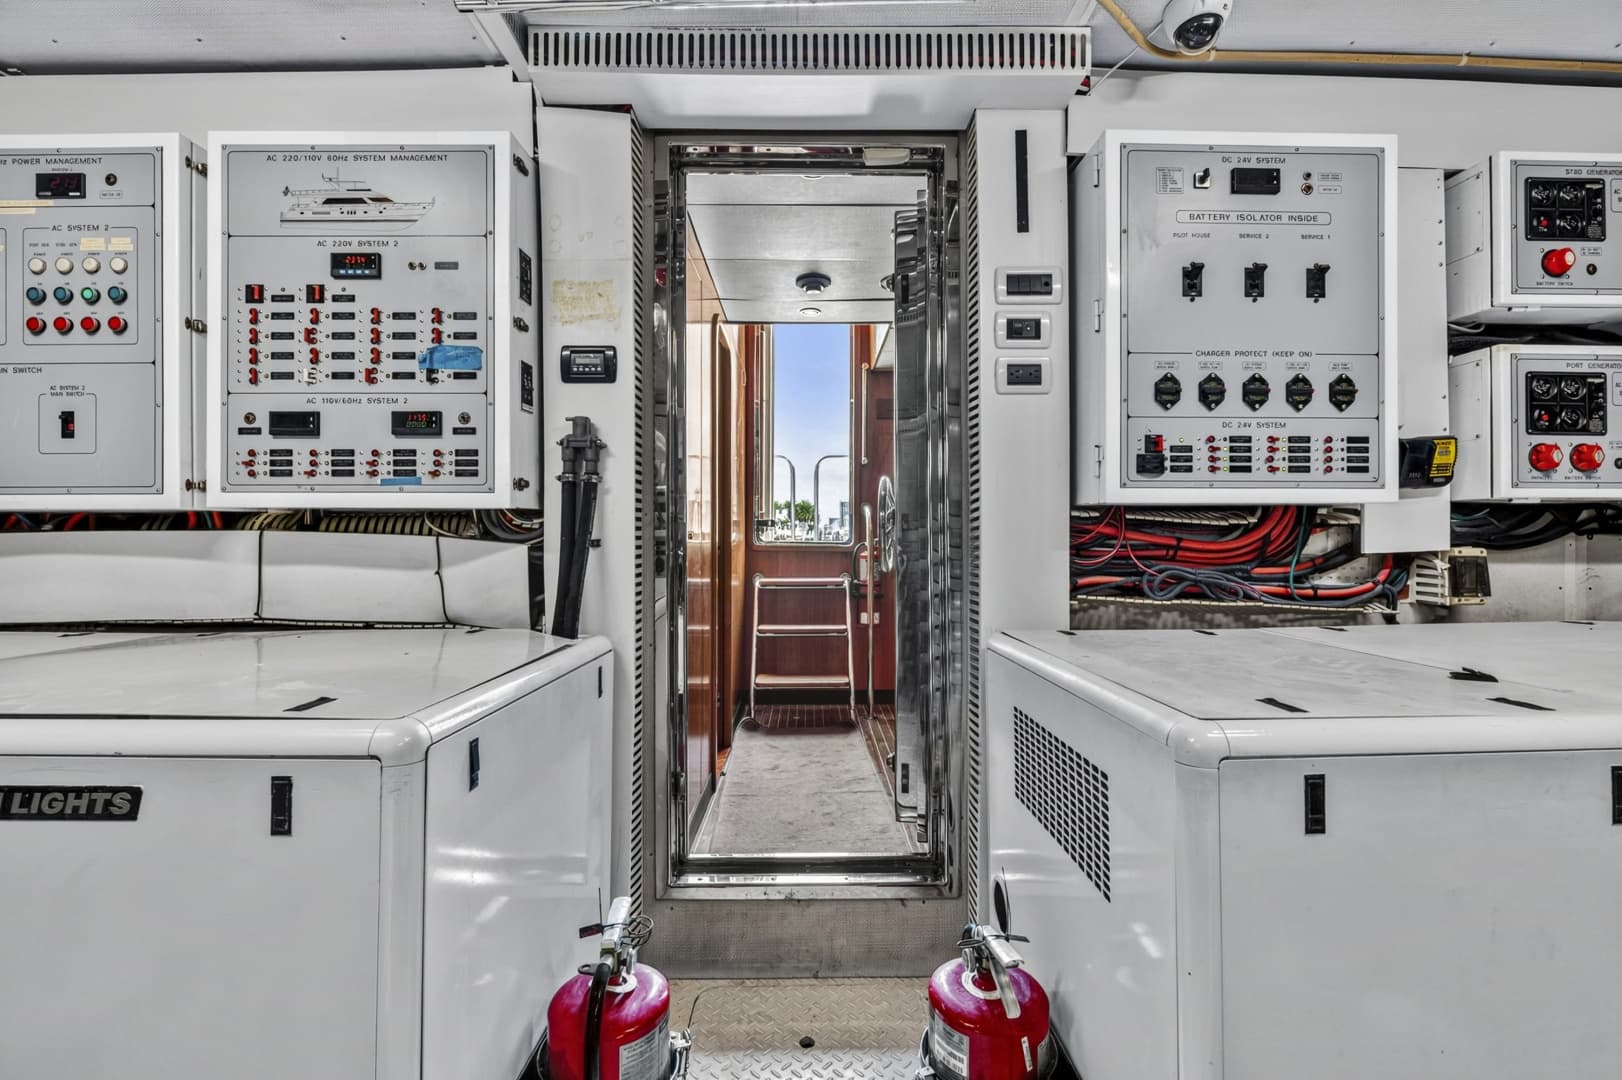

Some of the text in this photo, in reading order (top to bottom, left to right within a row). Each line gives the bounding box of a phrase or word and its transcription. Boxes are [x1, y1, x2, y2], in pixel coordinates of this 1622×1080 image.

[11, 157, 41, 166] POWER
[45, 157, 103, 165] MANAGEMENT
[266, 154, 449, 162] AC 220/110V 60Hz SYSTEM MANAGEMENT
[1221, 155, 1287, 165] DC 24V SYSTEM
[1188, 212, 1319, 223] BATTERY ISOLATOR INSIDE
[51, 224, 110, 232] AC SYSTEM 2
[1172, 231, 1189, 239] PILOT
[1300, 233, 1325, 241] SERVICE
[316, 239, 328, 248] AC
[332, 239, 353, 248] 220V
[357, 239, 389, 248] SYSTEM
[1195, 349, 1313, 358] CHARGER PROTECT (KEEP ON)
[12, 366, 43, 374] SWITCH
[305, 397, 317, 405] AC
[366, 397, 399, 405] SYSTEM
[1221, 421, 1287, 429] DC 24V SYSTEM
[10, 792, 132, 814] LIGHTS
